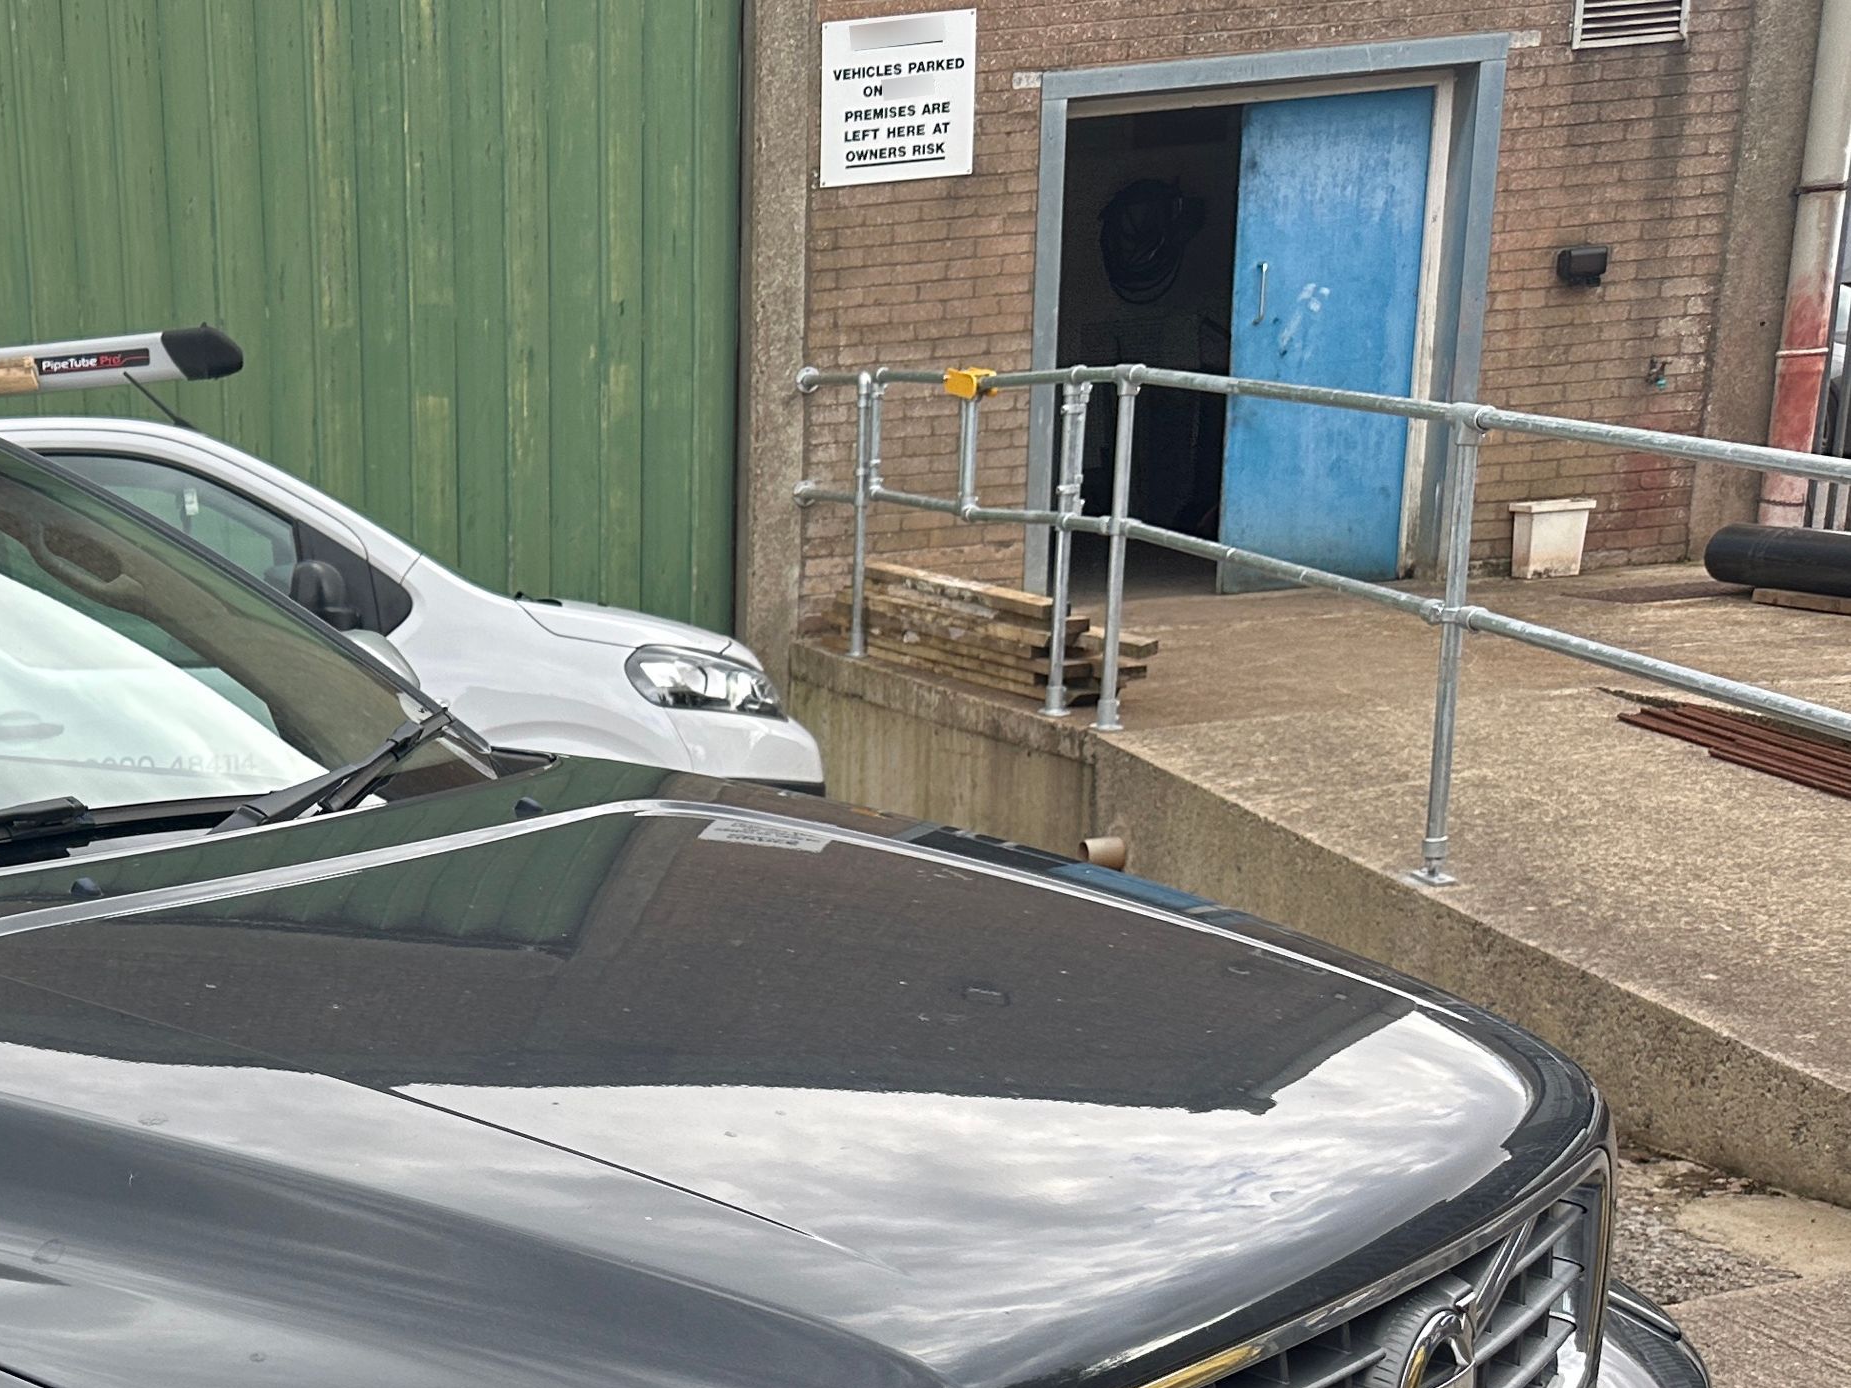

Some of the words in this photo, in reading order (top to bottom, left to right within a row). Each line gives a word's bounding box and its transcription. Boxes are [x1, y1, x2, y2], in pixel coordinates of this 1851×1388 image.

[833, 63, 902, 81] VEHICLES
[908, 57, 965, 74] PARKED
[863, 85, 883, 98] ON
[844, 105, 916, 123] PREMISES
[921, 101, 951, 115] ARE
[844, 128, 880, 143] LEFT
[887, 124, 926, 139] HERE
[932, 121, 951, 135] AT
[845, 145, 907, 162] OWNERS
[912, 142, 945, 156] RISK
[41, 358, 98, 372] PipeTube
